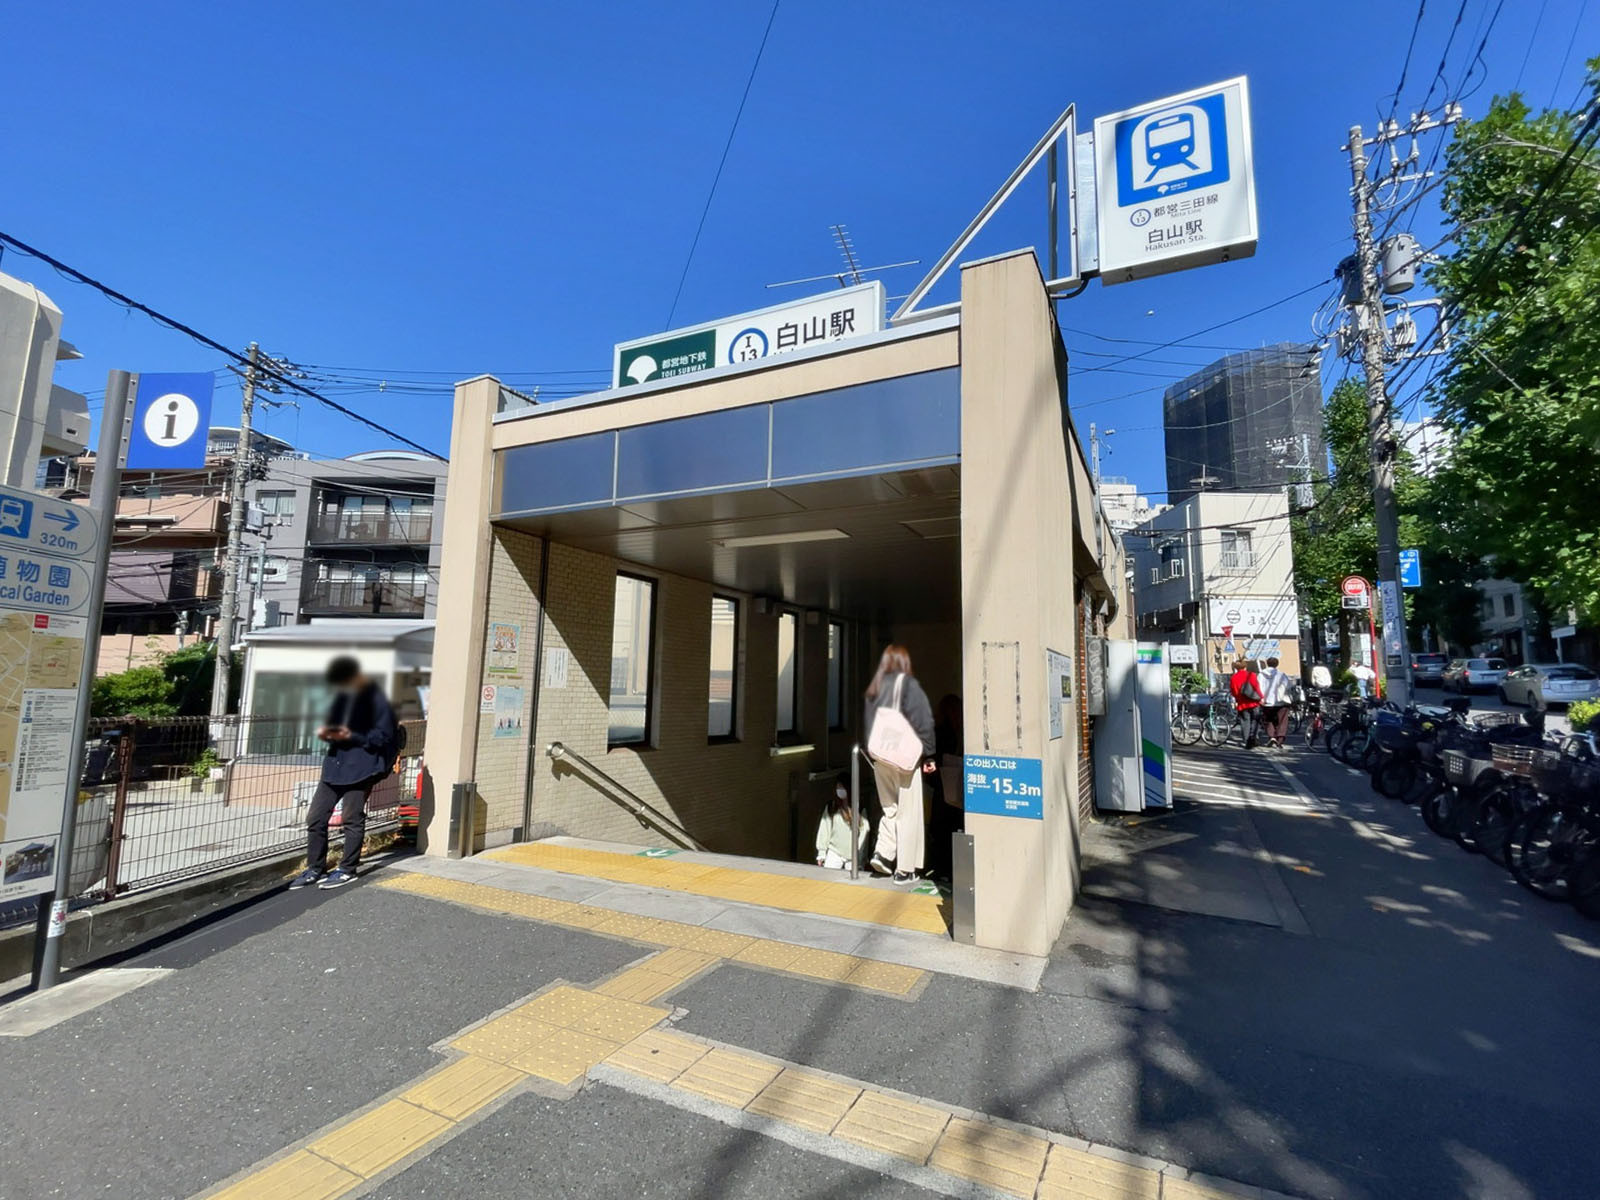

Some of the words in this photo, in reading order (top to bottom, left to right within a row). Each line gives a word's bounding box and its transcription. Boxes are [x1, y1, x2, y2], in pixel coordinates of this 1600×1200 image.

[1154, 193, 1218, 217] 都営三田線
[1148, 219, 1203, 244] 白山駅
[1144, 238, 1186, 252] Hakusan
[1188, 233, 1207, 243] Sta.
[776, 308, 855, 349] 白山駅
[662, 350, 707, 370] 都営地下鉄
[740, 348, 758, 362] 13
[678, 362, 707, 375] SUBWAY
[40, 532, 78, 551] 320m
[23, 585, 70, 606] Garden
[966, 758, 1017, 769] この出入口は
[992, 777, 1041, 797] 15.3m
